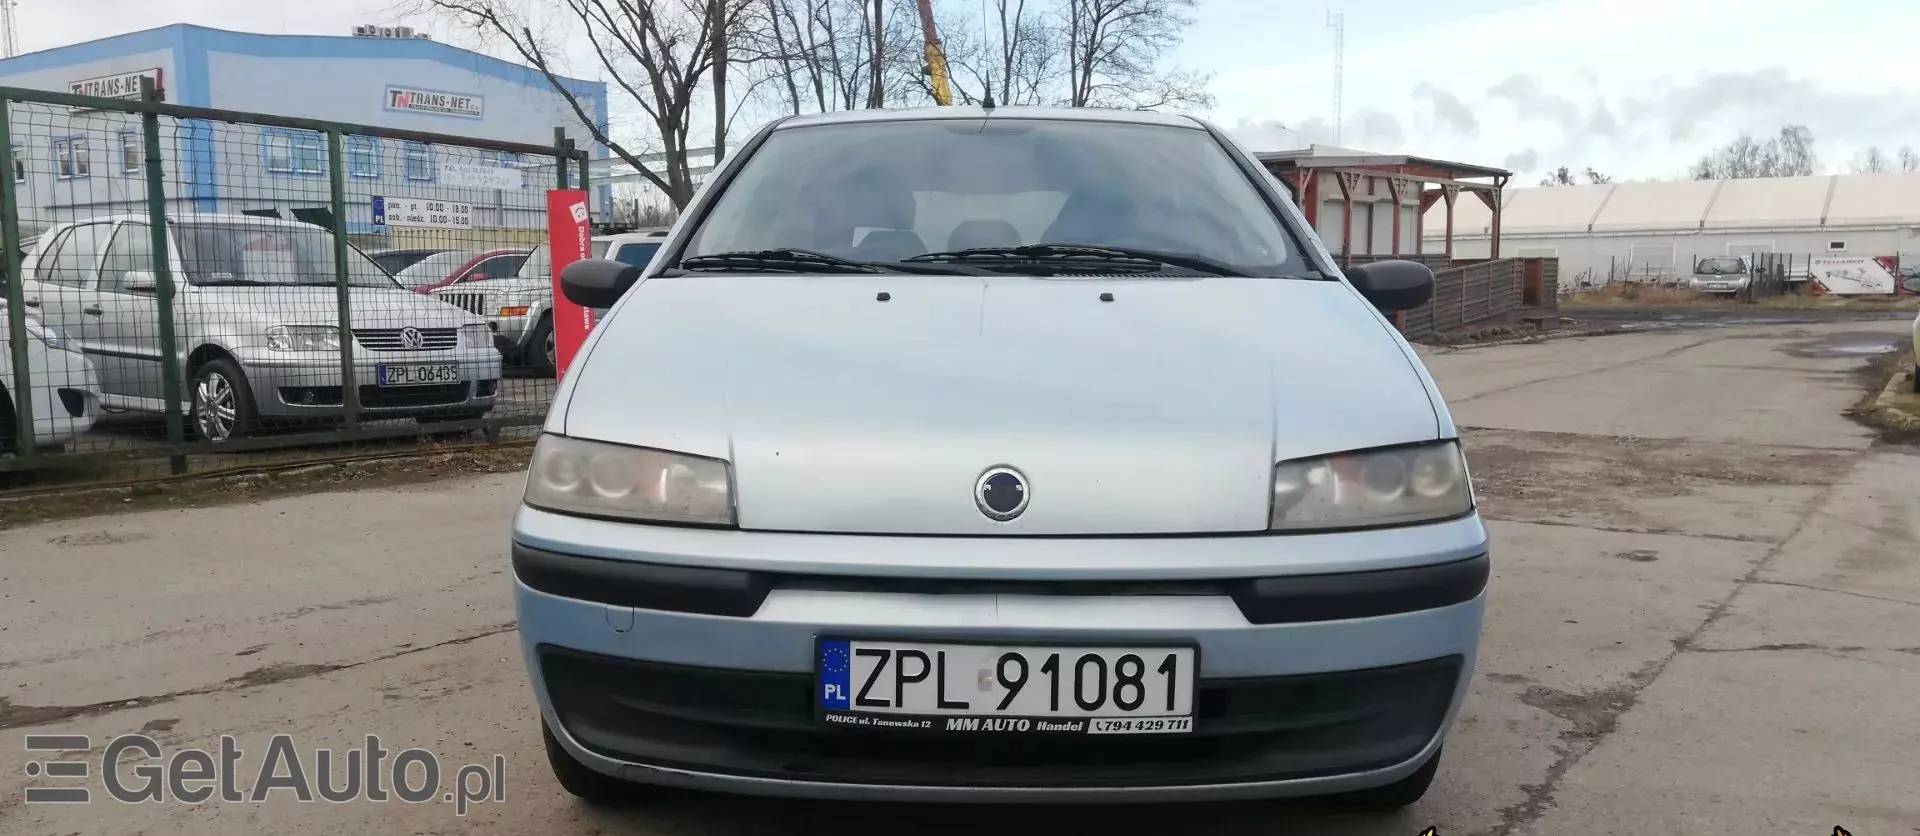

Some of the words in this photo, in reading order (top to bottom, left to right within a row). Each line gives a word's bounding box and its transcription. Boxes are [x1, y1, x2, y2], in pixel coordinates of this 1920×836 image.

[88, 75, 144, 97] TRANS-NE
[410, 92, 471, 110] TRANS-NET
[426, 203, 443, 211] 10.00
[430, 214, 447, 223] 10.00
[578, 226, 586, 251] Dobra
[387, 367, 414, 383] ZPL
[419, 366, 457, 381] 06435
[855, 648, 969, 710] ZPL
[996, 651, 1177, 712] 91081
[825, 684, 846, 700] PL
[825, 714, 858, 724] POLICE
[858, 717, 870, 725] ul.
[872, 718, 919, 728] Tanowska
[921, 720, 931, 728] 12
[946, 718, 980, 731] MM
[981, 718, 1030, 731] AUTO
[1036, 721, 1083, 732] Handel
[1105, 721, 1132, 731] 794
[1135, 720, 1163, 731] 429
[1167, 719, 1189, 730] 711
